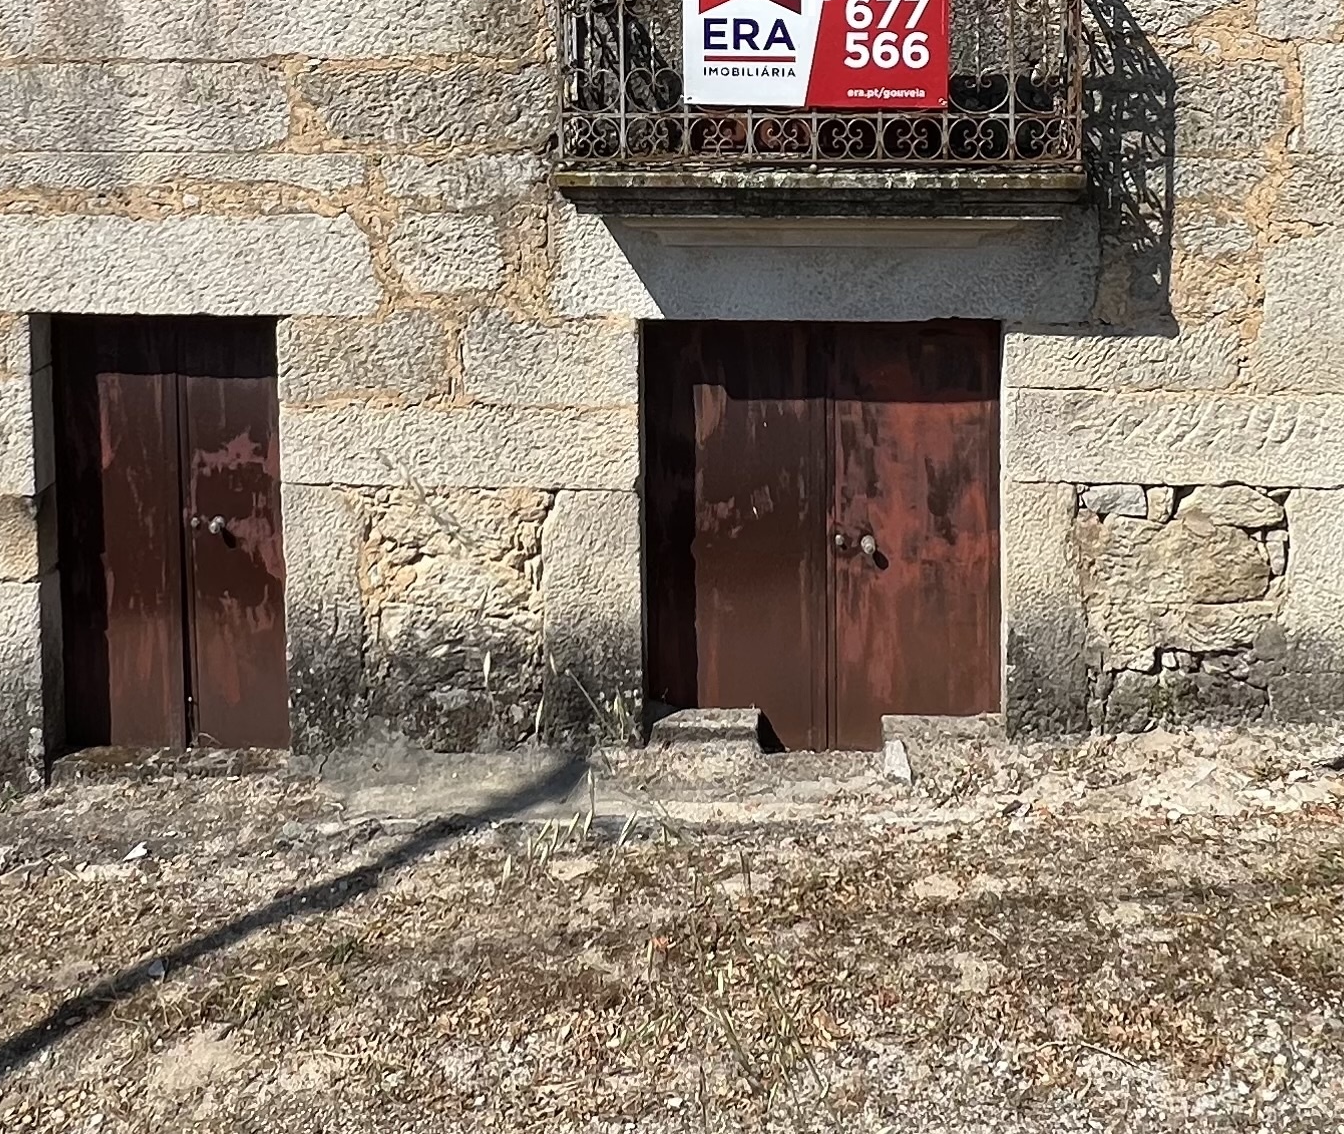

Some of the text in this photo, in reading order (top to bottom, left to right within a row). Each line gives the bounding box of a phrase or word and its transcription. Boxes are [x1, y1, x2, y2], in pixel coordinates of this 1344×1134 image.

[703, 18, 796, 51] ERA
[843, 31, 930, 69] 566
[703, 65, 796, 77] IMOBILIÁRIA
[846, 87, 926, 99] era.pt/gouveia
